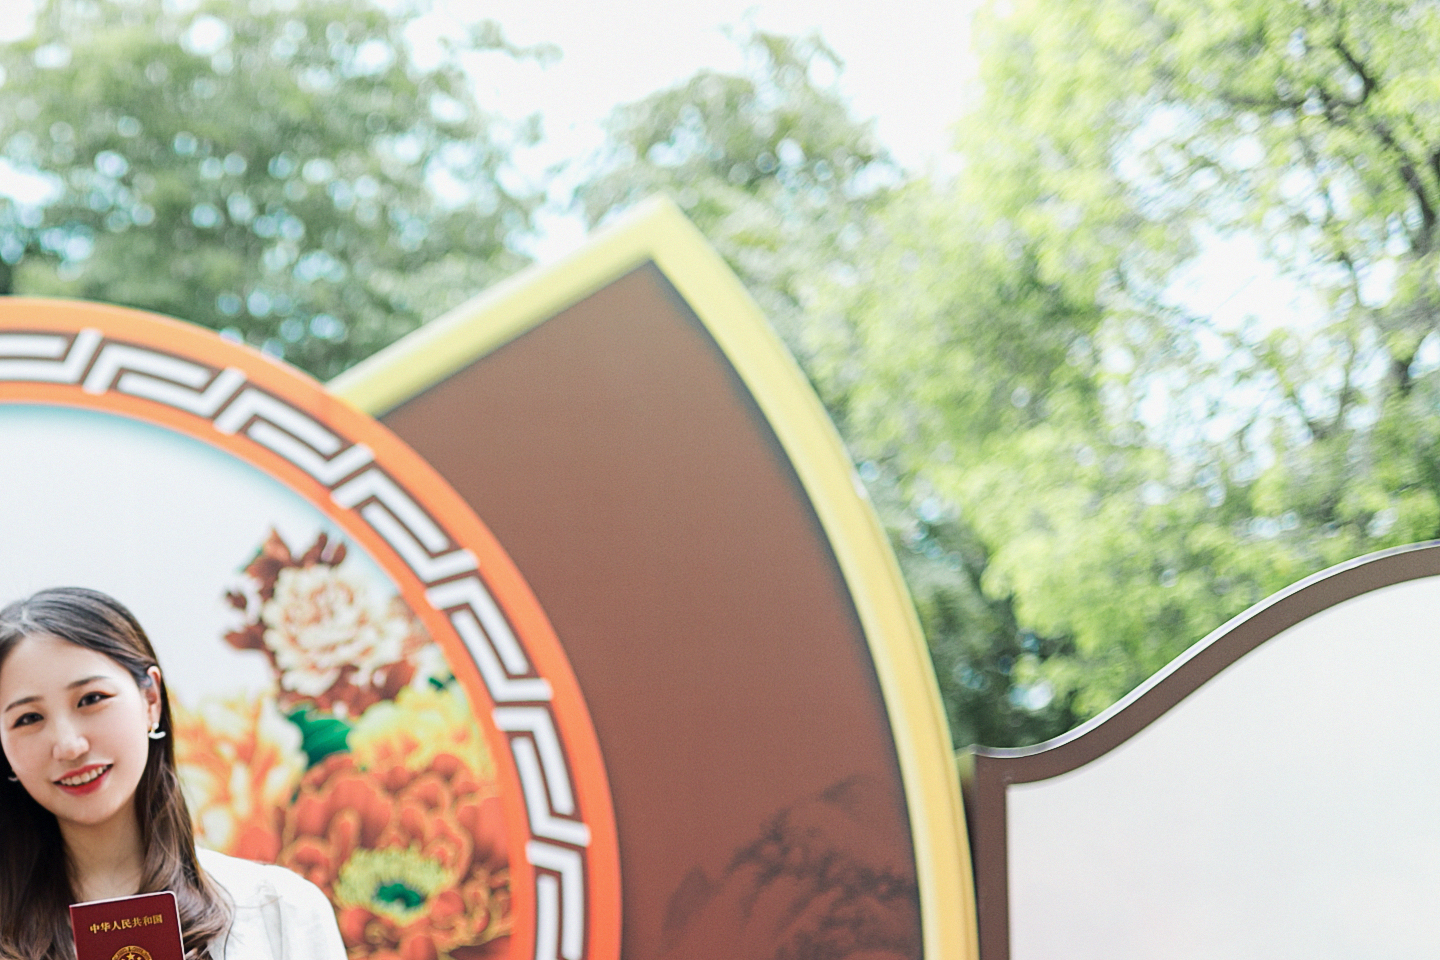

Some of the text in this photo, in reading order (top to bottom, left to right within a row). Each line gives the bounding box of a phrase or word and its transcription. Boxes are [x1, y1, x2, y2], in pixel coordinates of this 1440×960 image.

[89, 914, 163, 934] 中华人民共和国
